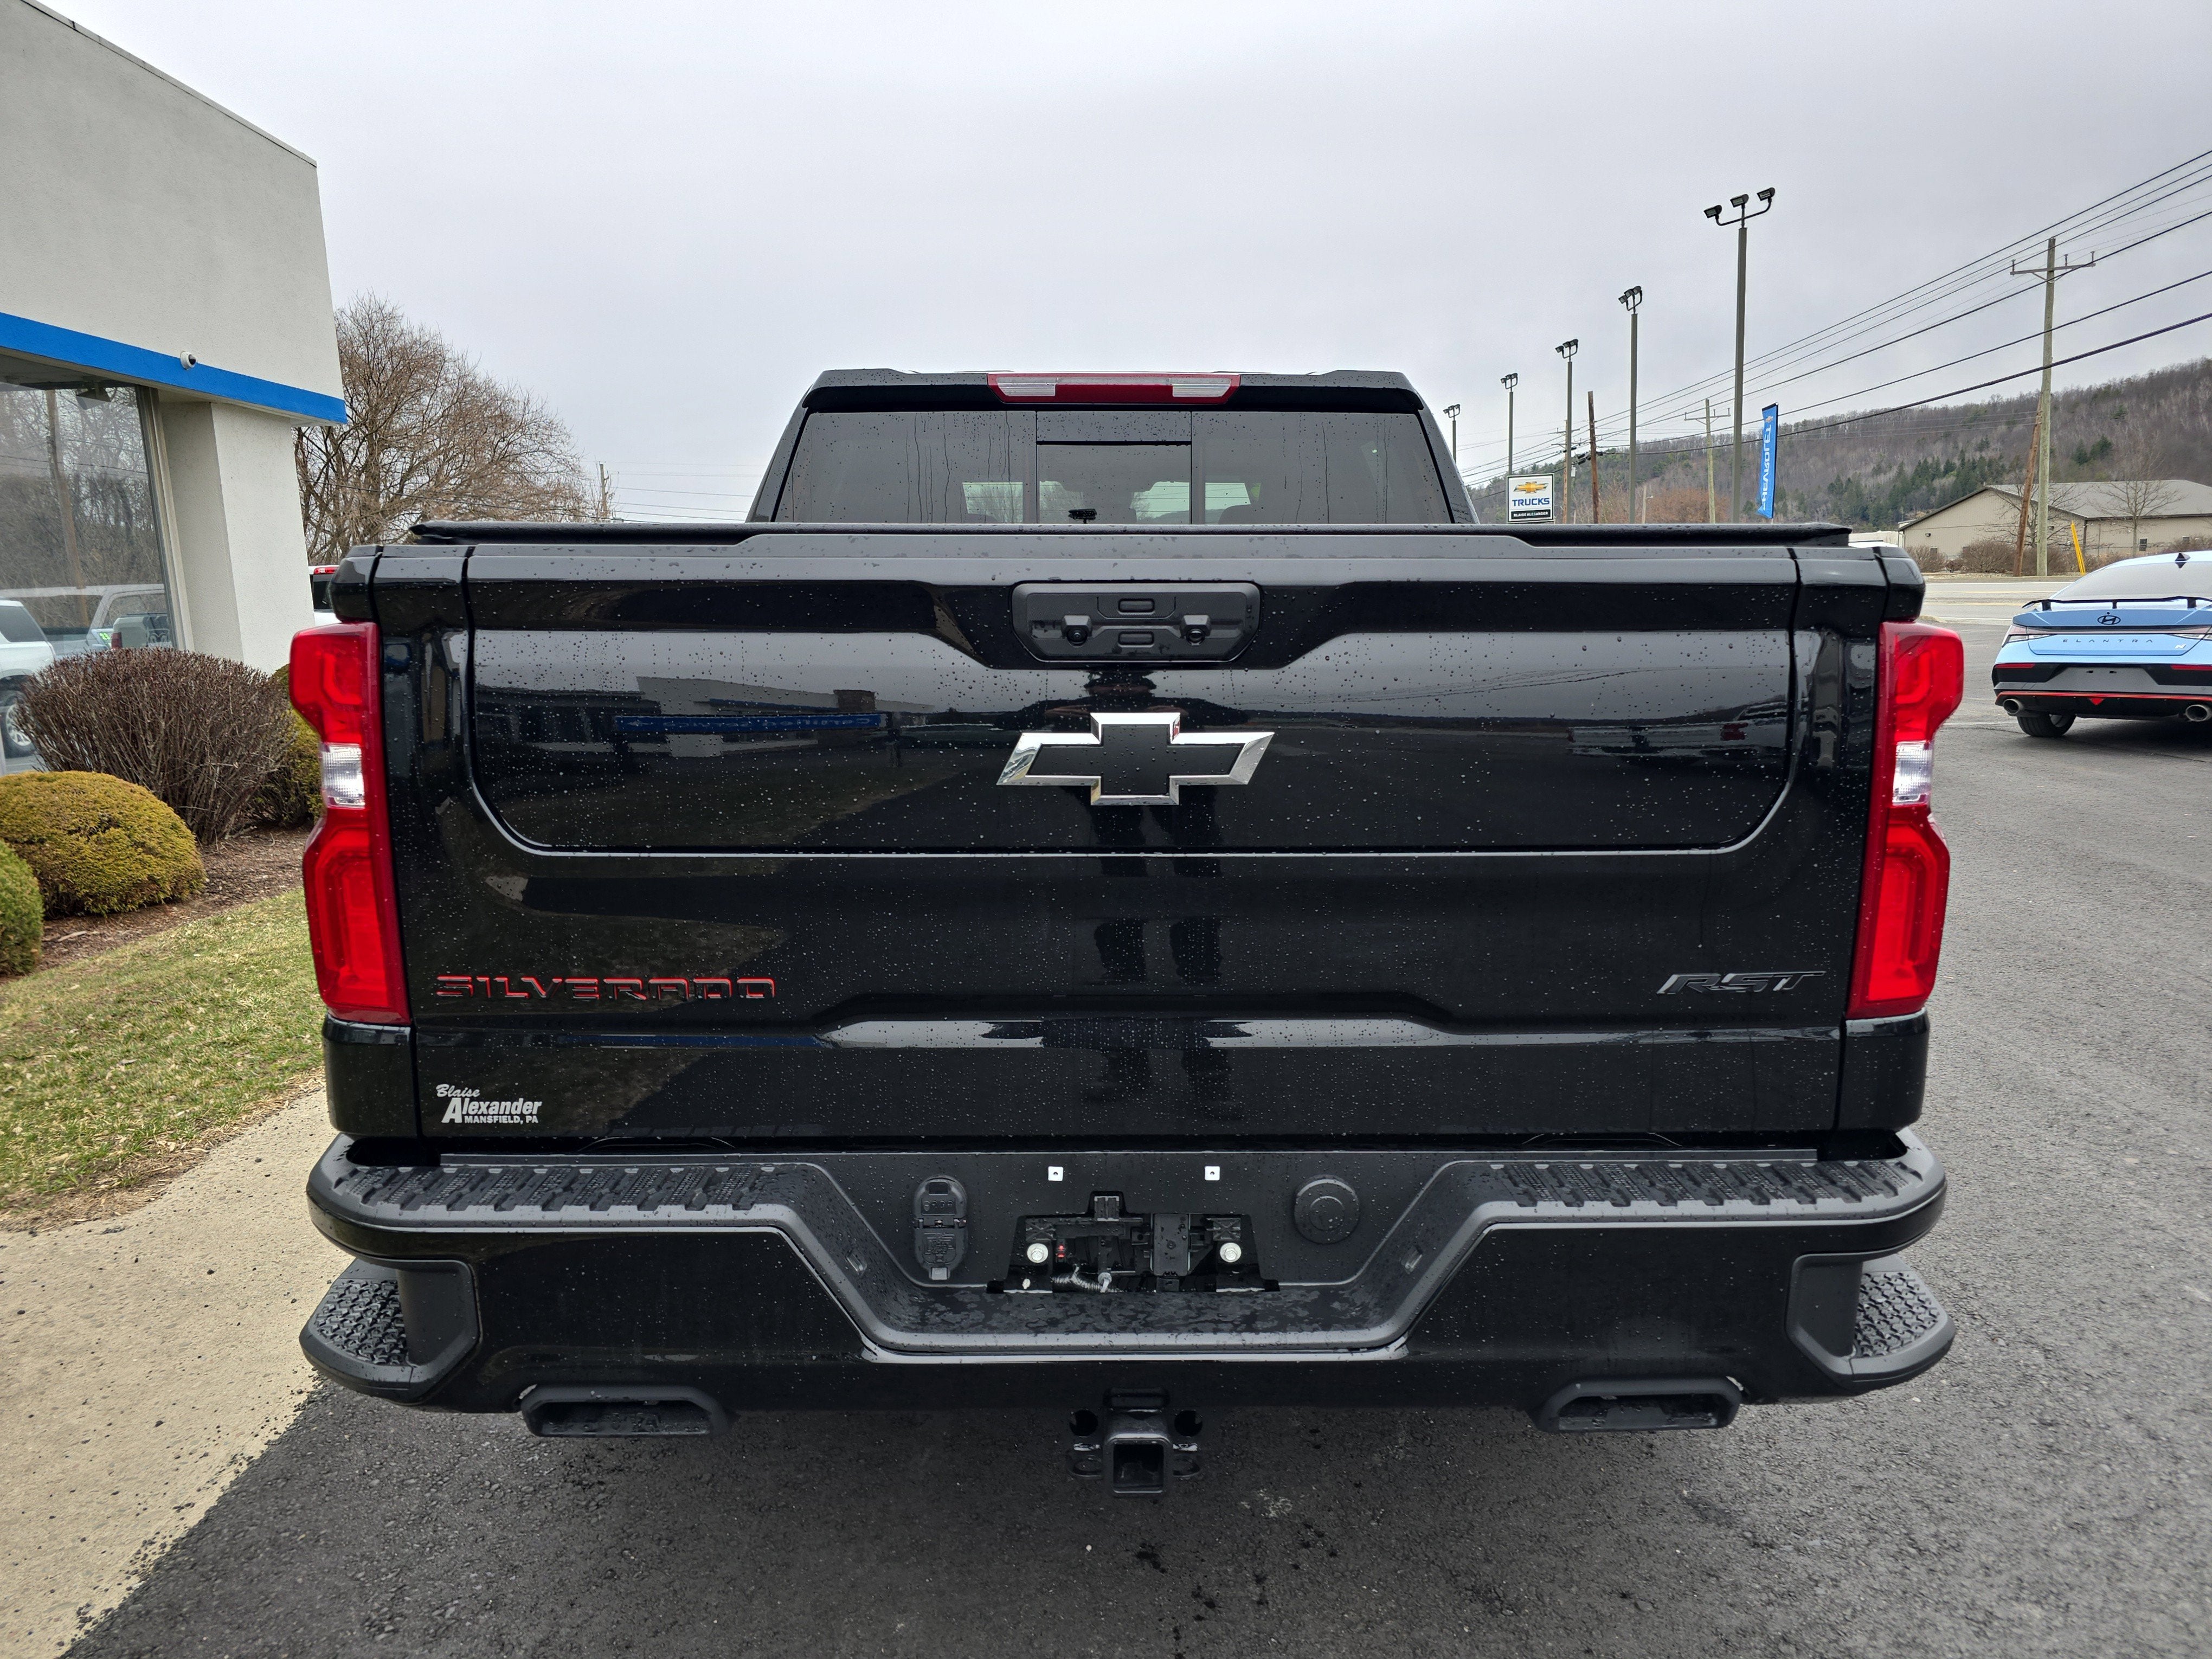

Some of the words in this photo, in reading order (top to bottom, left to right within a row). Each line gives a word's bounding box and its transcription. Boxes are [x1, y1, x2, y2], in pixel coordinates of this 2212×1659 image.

[1512, 498, 1549, 506] TRUCKS
[435, 975, 776, 1000] SILVERADO
[1656, 970, 1827, 995] RST
[435, 1083, 481, 1098] Blaise
[441, 1097, 543, 1123] Alexander
[464, 1115, 524, 1125] MANSFIELD,
[525, 1115, 539, 1123] PA
